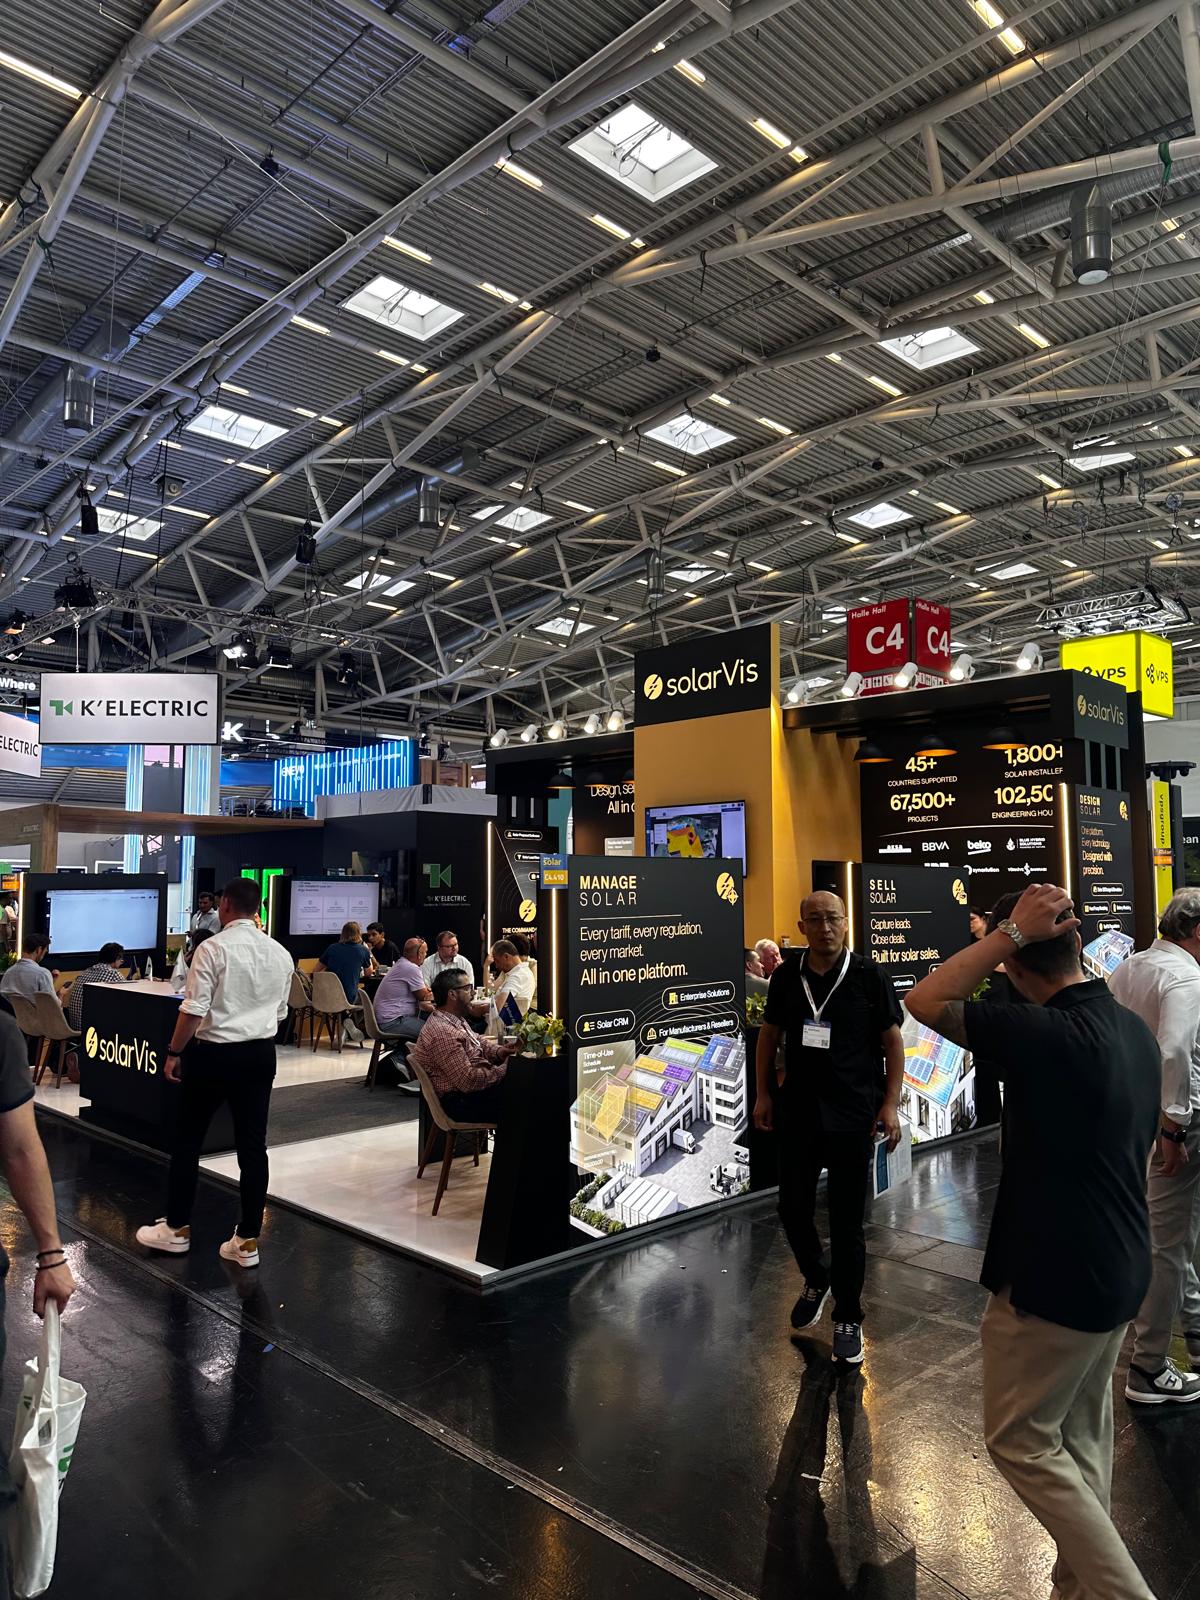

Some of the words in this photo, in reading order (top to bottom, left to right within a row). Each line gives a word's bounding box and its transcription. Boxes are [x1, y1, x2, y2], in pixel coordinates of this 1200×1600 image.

[852, 609, 869, 619] Halle
[872, 605, 886, 614] Hall
[931, 607, 939, 615] Hall
[866, 622, 904, 654] C4
[927, 626, 950, 657] C4
[666, 658, 758, 696] solarVis
[1096, 666, 1126, 680] VPS
[1156, 670, 1169, 683] VPS
[1088, 700, 1124, 726] solarVis
[905, 756, 937, 772] 45+
[1004, 770, 1028, 778] SOLAR
[888, 778, 920, 787] COUNTRIES
[921, 776, 958, 785] SUPPORTED
[890, 792, 955, 812] 67,500+
[1080, 794, 1100, 805] DESIGN
[608, 801, 619, 814] All
[621, 800, 630, 813] in
[1080, 806, 1100, 816] SOLAR
[992, 810, 1036, 819] ENGINEERING
[922, 841, 950, 851] BBVA
[1082, 851, 1103, 863] Designed
[580, 875, 637, 890] MANAGE
[870, 880, 896, 890] SELL
[579, 892, 637, 906] SOLAR
[870, 892, 896, 904] SOLAR
[871, 918, 894, 931] Capture
[580, 926, 608, 943] Every
[610, 924, 632, 940] tariff,
[633, 926, 658, 940] every
[660, 922, 703, 939] regulation,
[871, 933, 888, 944] Close
[580, 948, 608, 963] every
[609, 944, 644, 959] market.
[890, 949, 901, 962] for
[901, 948, 919, 962] solar
[920, 947, 940, 960] sales.
[580, 968, 596, 986] All
[599, 968, 610, 984] in
[612, 969, 636, 983] one
[638, 963, 688, 983] platform.
[680, 992, 706, 1002] Enterprise
[707, 989, 730, 998] Solutions
[596, 1019, 612, 1029] Solar
[613, 1017, 629, 1026] CRM
[659, 1029, 668, 1037] For
[669, 1024, 706, 1035] Manufacturers
[99, 1034, 157, 1075] solarVis
